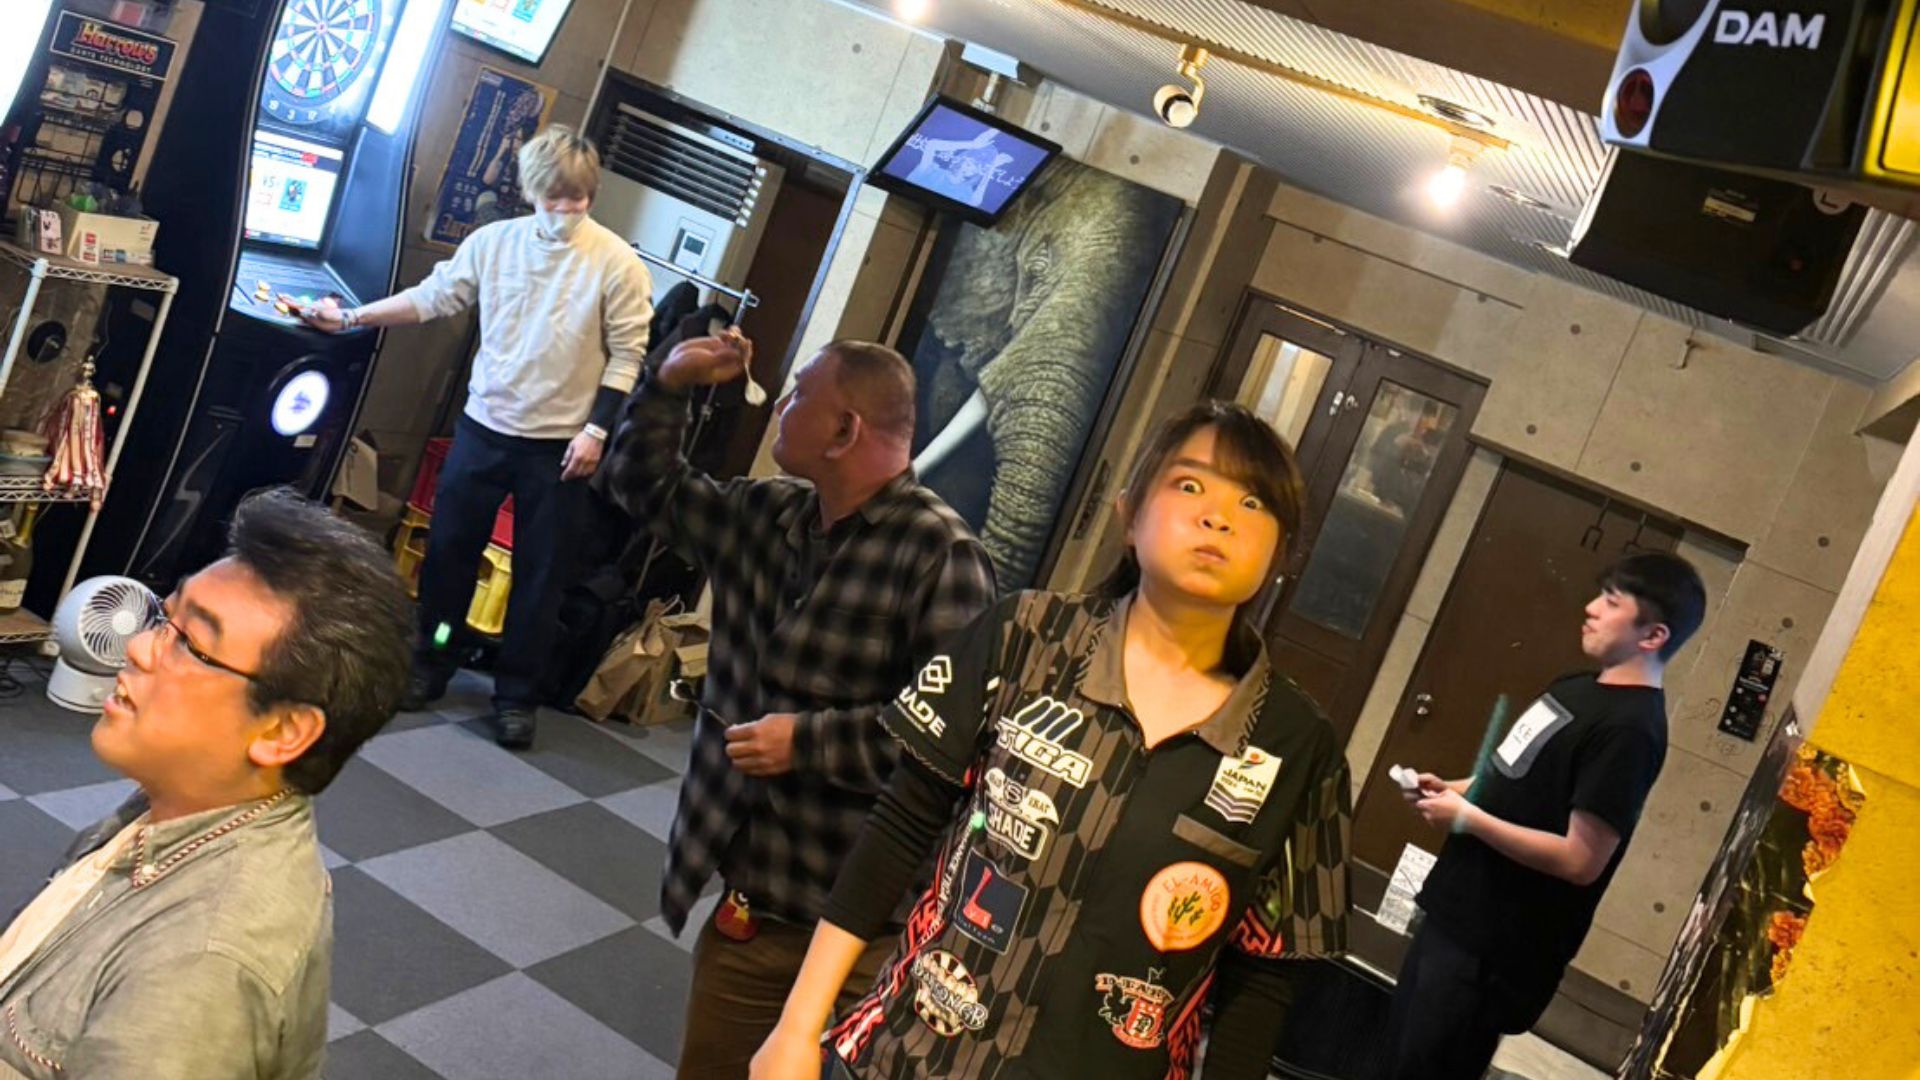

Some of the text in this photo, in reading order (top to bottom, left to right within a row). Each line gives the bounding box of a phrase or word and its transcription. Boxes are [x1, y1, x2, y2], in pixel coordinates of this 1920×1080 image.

[71, 20, 158, 65] Harrows
[1714, 10, 1825, 49] DAM
[1222, 768, 1267, 791] JAPAN
[1163, 873, 1221, 912] EL-AMIGO
